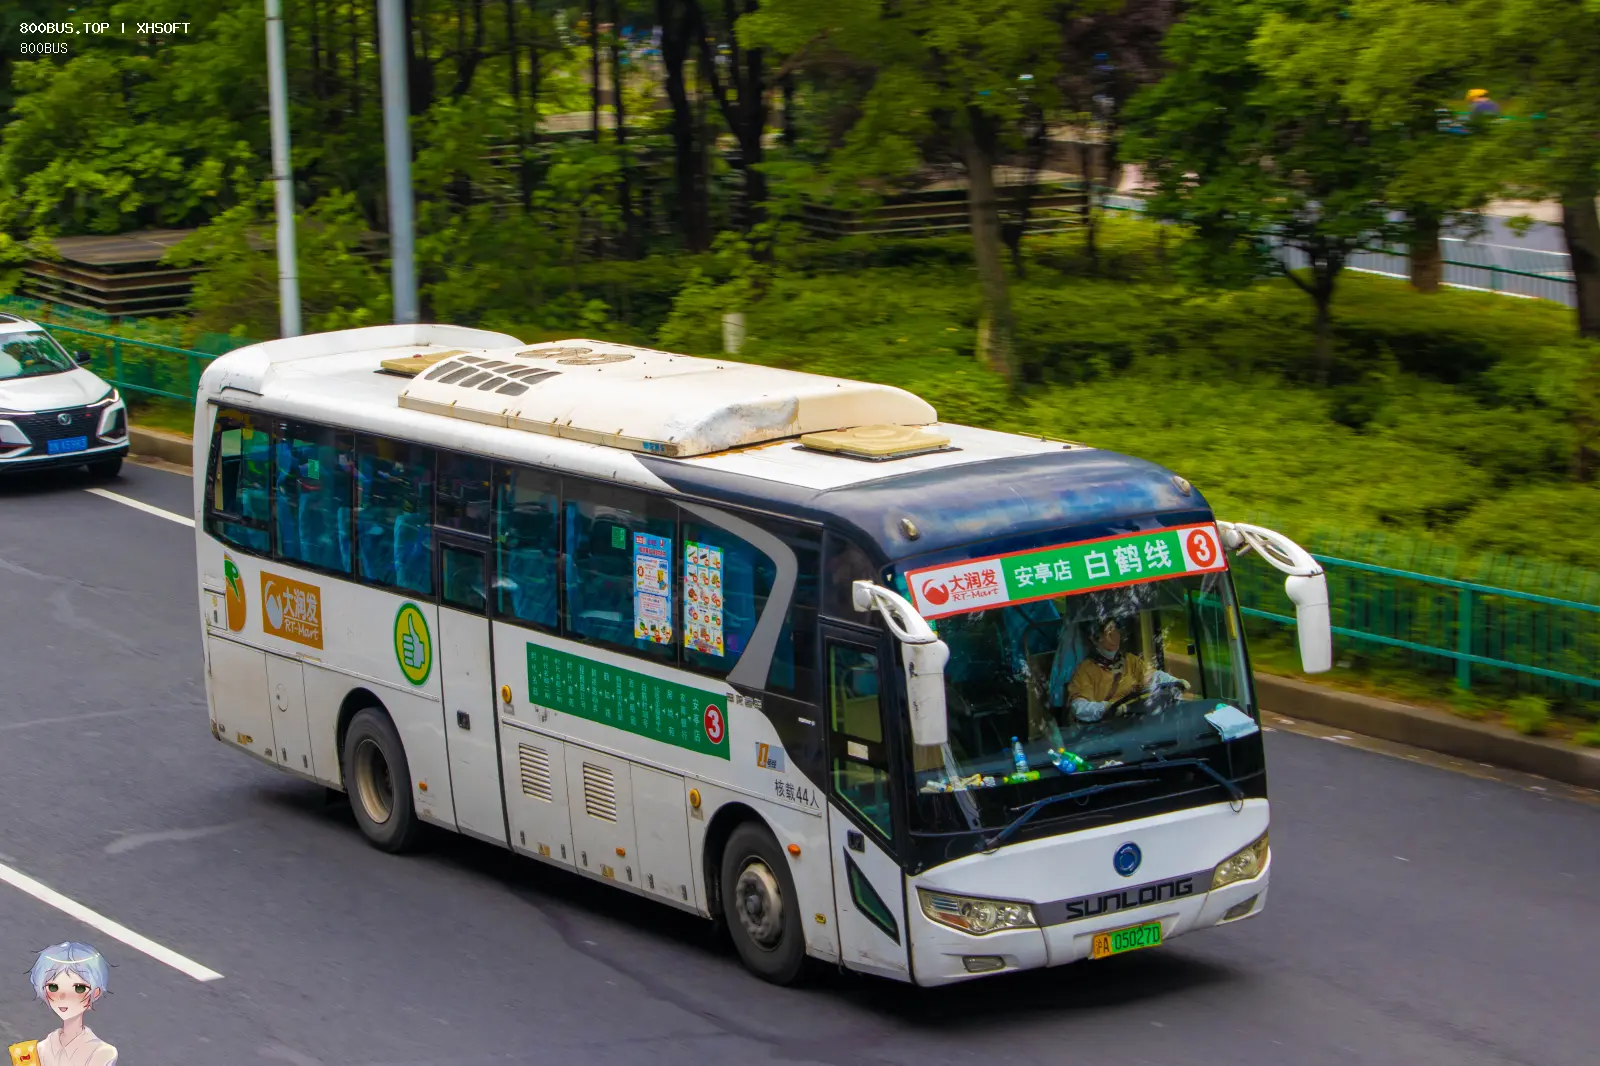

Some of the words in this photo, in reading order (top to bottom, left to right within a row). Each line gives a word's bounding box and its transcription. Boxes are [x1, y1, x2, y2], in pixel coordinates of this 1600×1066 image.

[1195, 534, 1209, 561] 3
[1014, 559, 1072, 588] 安亭店
[1083, 539, 1173, 580] 白鹤线
[949, 569, 998, 592] 大润发
[282, 585, 318, 624] 大润发
[707, 709, 721, 739] 3
[774, 778, 820, 809] 核载44人
[1066, 878, 1193, 919] SUNLONG
